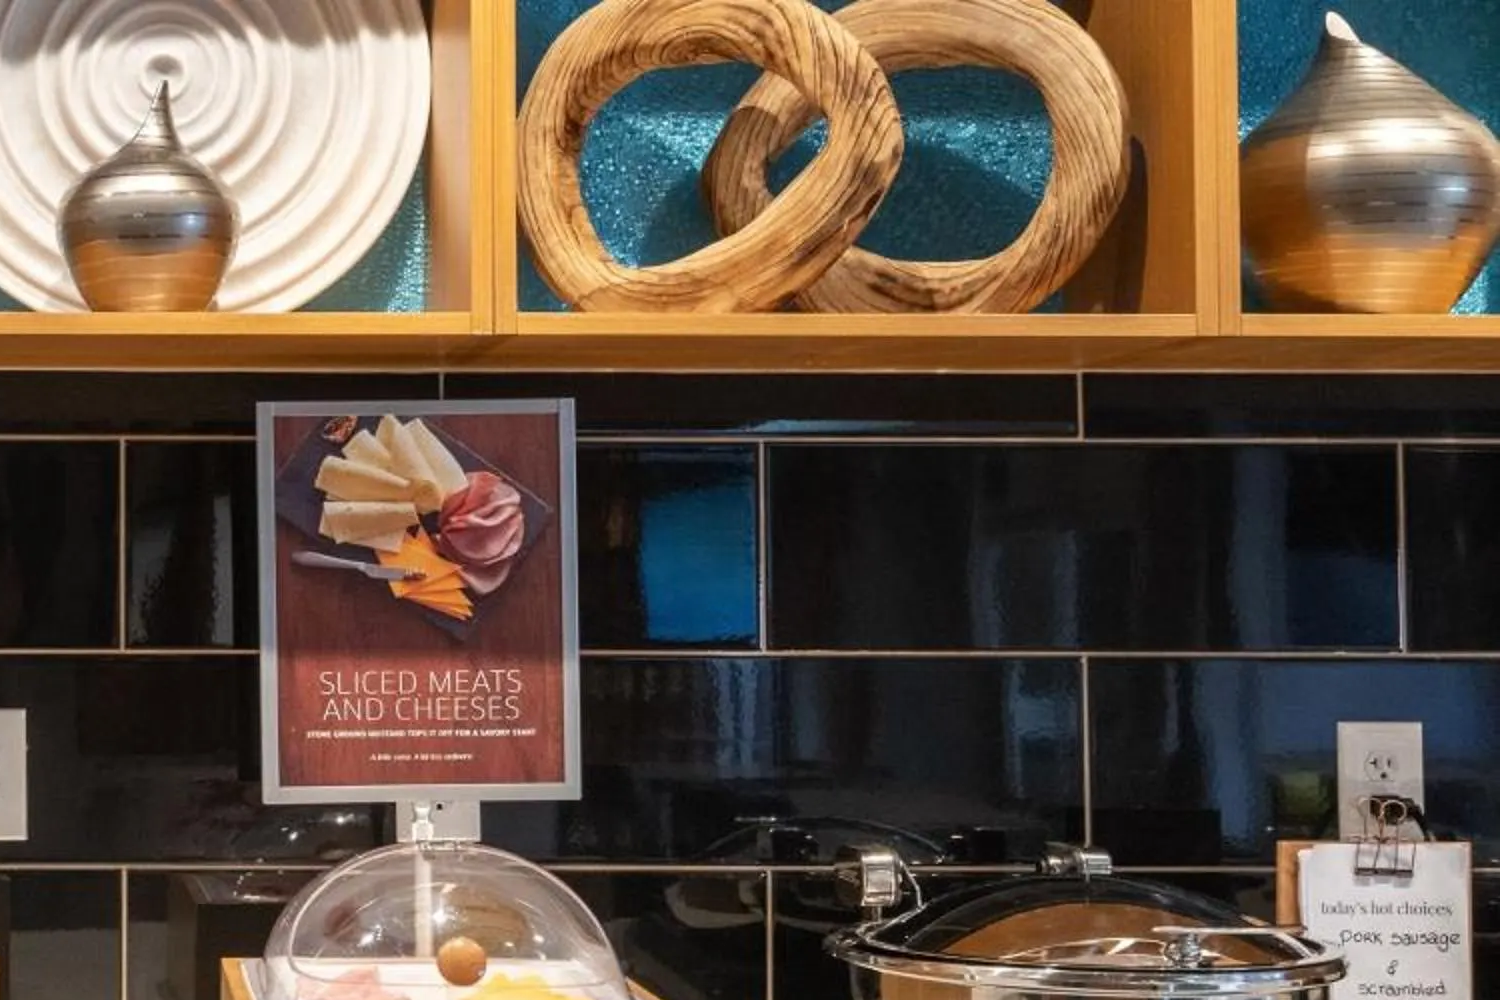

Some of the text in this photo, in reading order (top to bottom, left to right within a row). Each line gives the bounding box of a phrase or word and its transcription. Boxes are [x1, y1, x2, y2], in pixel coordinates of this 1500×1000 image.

[319, 669, 523, 696] SLICED MEATS
[322, 695, 520, 721] AND CHEESES
[1321, 900, 1453, 916] today's hot choices
[1390, 931, 1461, 953] sausage
[1357, 979, 1448, 997] scrambled
